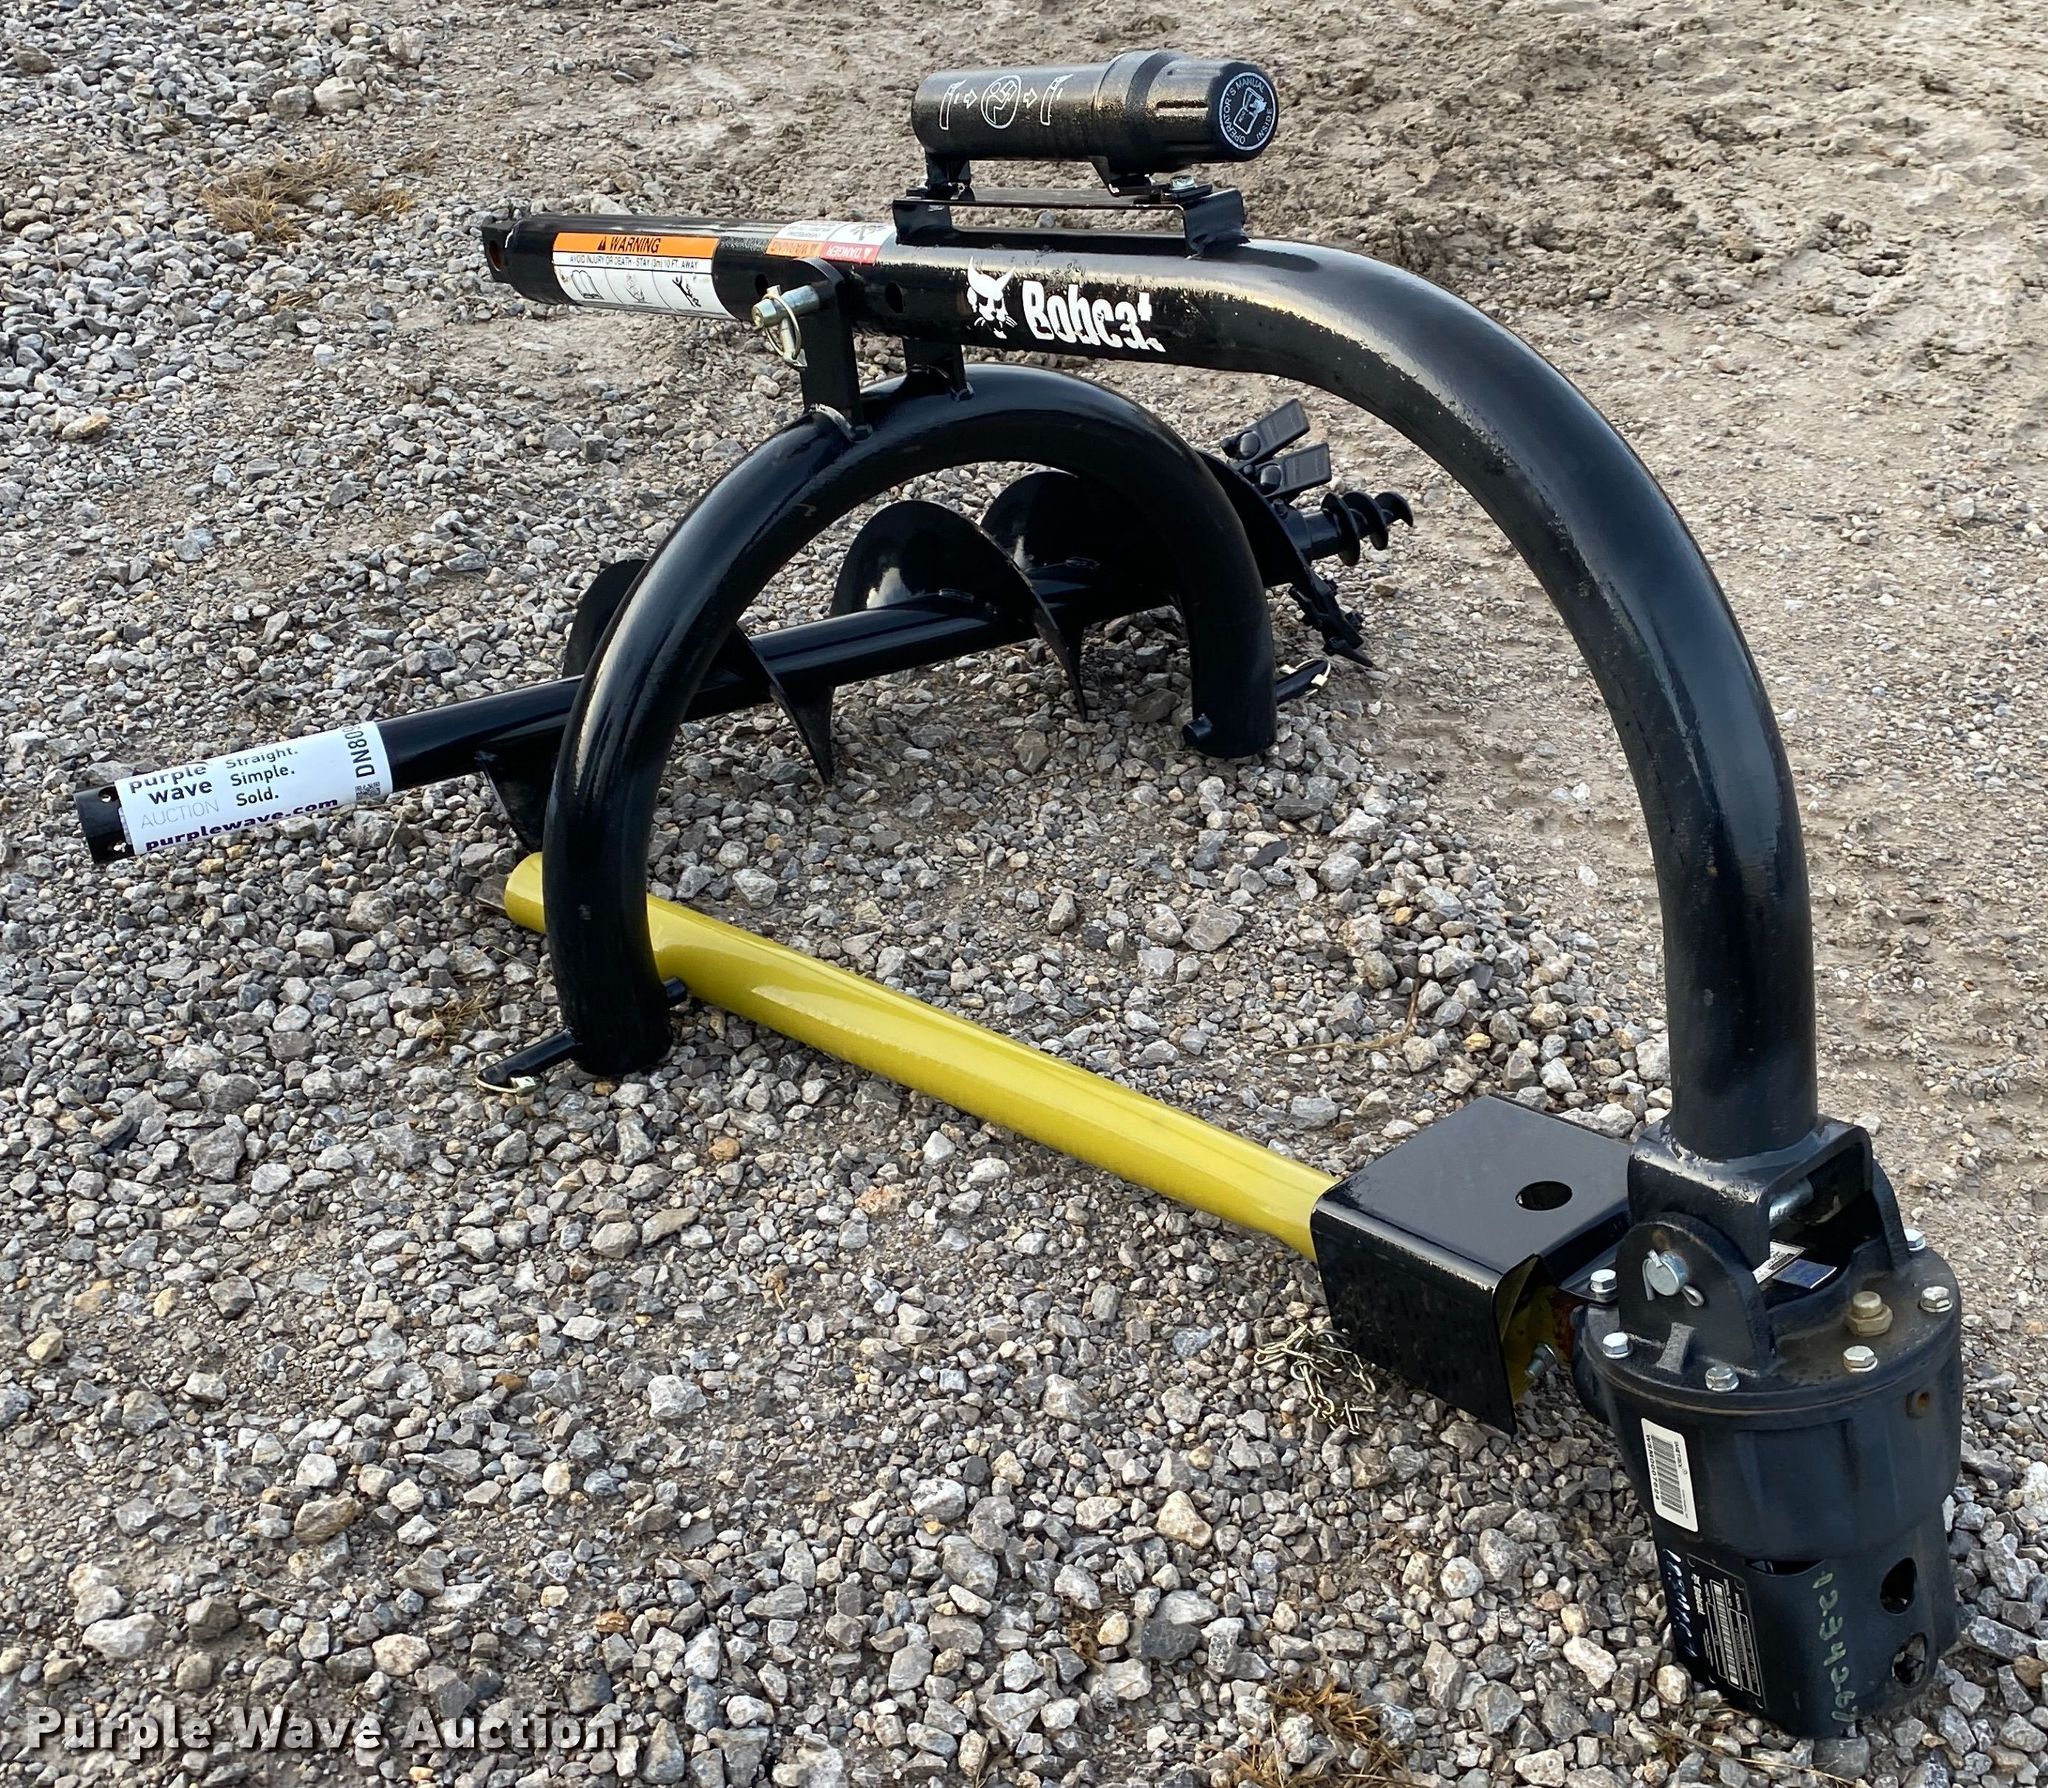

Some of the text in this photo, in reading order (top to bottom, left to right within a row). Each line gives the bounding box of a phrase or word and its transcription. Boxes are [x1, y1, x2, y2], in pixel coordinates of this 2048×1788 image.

[1223, 77, 1273, 145] OPERATOR'S MANUAL INSIDE
[610, 236, 661, 253] WARNING
[827, 245, 859, 258] DANGER
[570, 255, 586, 263] AVOID
[586, 255, 605, 264] INJURY
[605, 256, 613, 264] OR
[614, 257, 632, 265] DEATH
[636, 258, 650, 266] STAY
[664, 259, 670, 267] 10
[681, 260, 698, 270] AWAY
[1022, 280, 1166, 352] Bobcat
[225, 748, 299, 769] Straight.
[129, 765, 207, 793] purple
[230, 764, 295, 787] Simple.
[148, 780, 213, 805] wave
[235, 787, 279, 807] Sold.
[140, 799, 220, 830] AUCTION
[145, 798, 338, 852] purplewave.com
